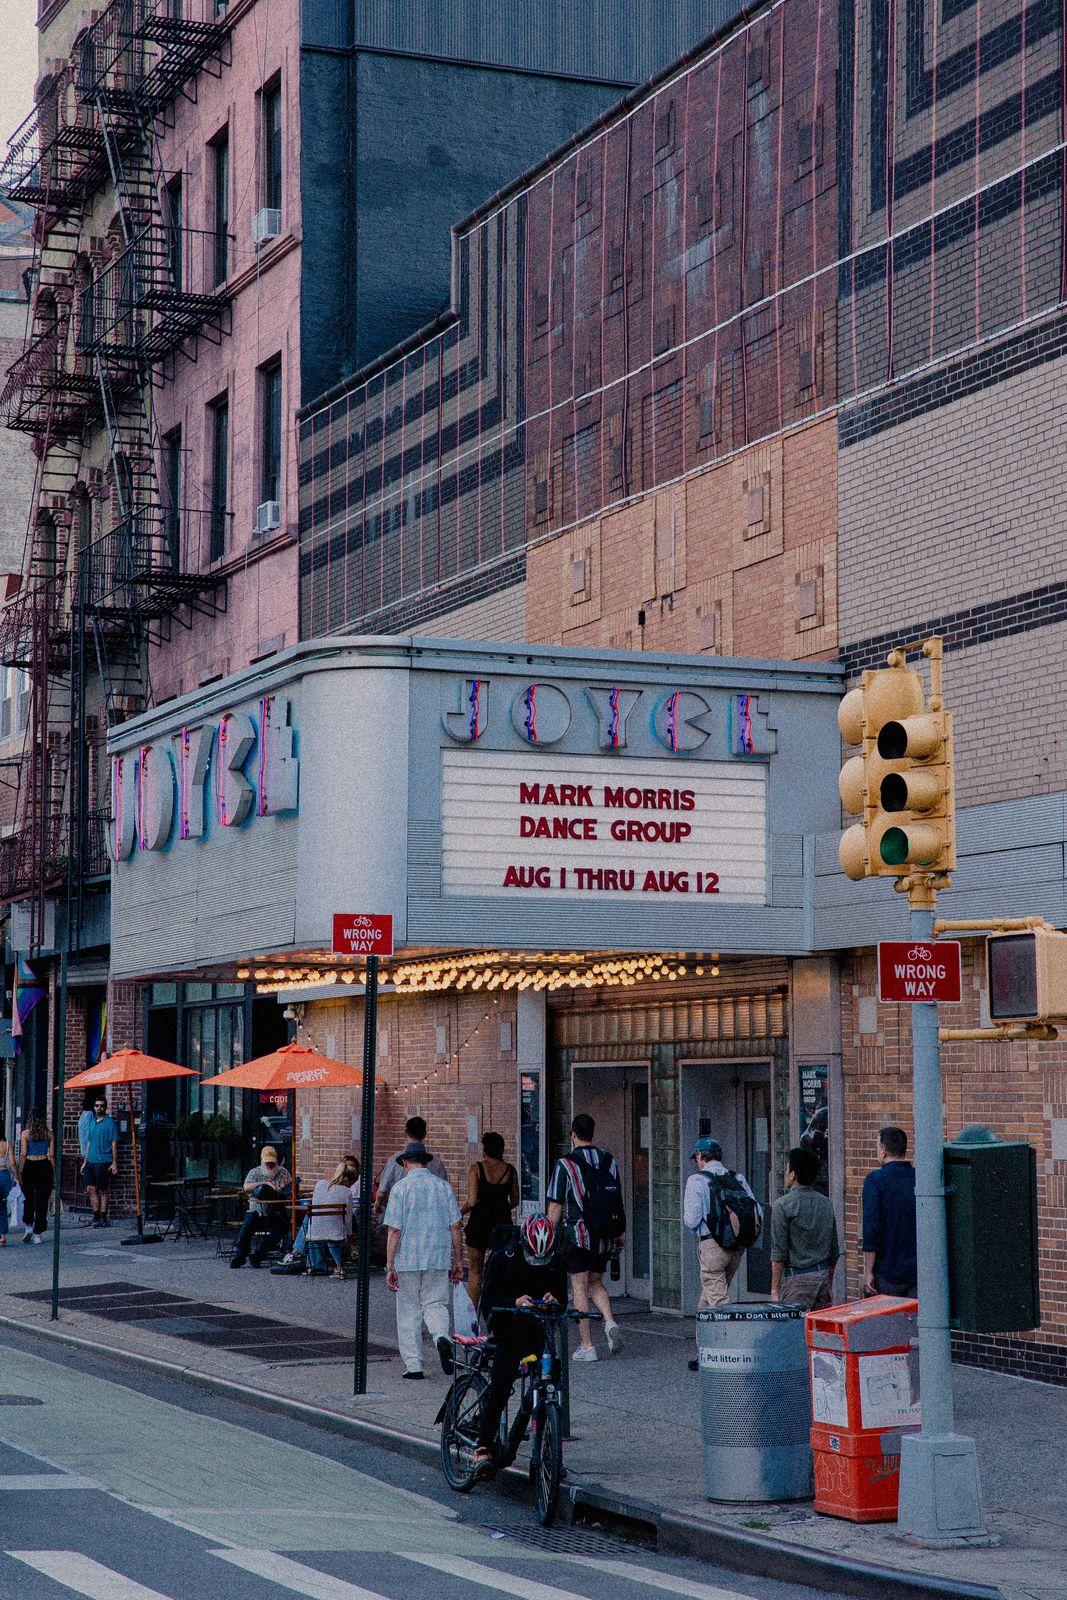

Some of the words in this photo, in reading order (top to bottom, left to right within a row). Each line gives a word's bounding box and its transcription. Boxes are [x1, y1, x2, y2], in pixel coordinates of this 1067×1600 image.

[442, 680, 778, 755] JOYCE
[104, 695, 299, 863] JOYCE
[520, 782, 593, 807] MARK
[604, 786, 696, 811] MORRIS
[520, 815, 598, 840] DANCE
[611, 819, 692, 843] GROUP
[503, 865, 551, 889] AUG
[574, 868, 634, 891] THRU
[643, 870, 689, 893] AUG
[697, 871, 720, 894] 12
[343, 928, 382, 940] WRONG
[350, 940, 374, 952] WAY
[894, 964, 946, 979] WRONG
[904, 981, 936, 996] WAY
[707, 1354, 719, 1363] Put
[720, 1353, 741, 1363] litter
[742, 1354, 752, 1363] in
